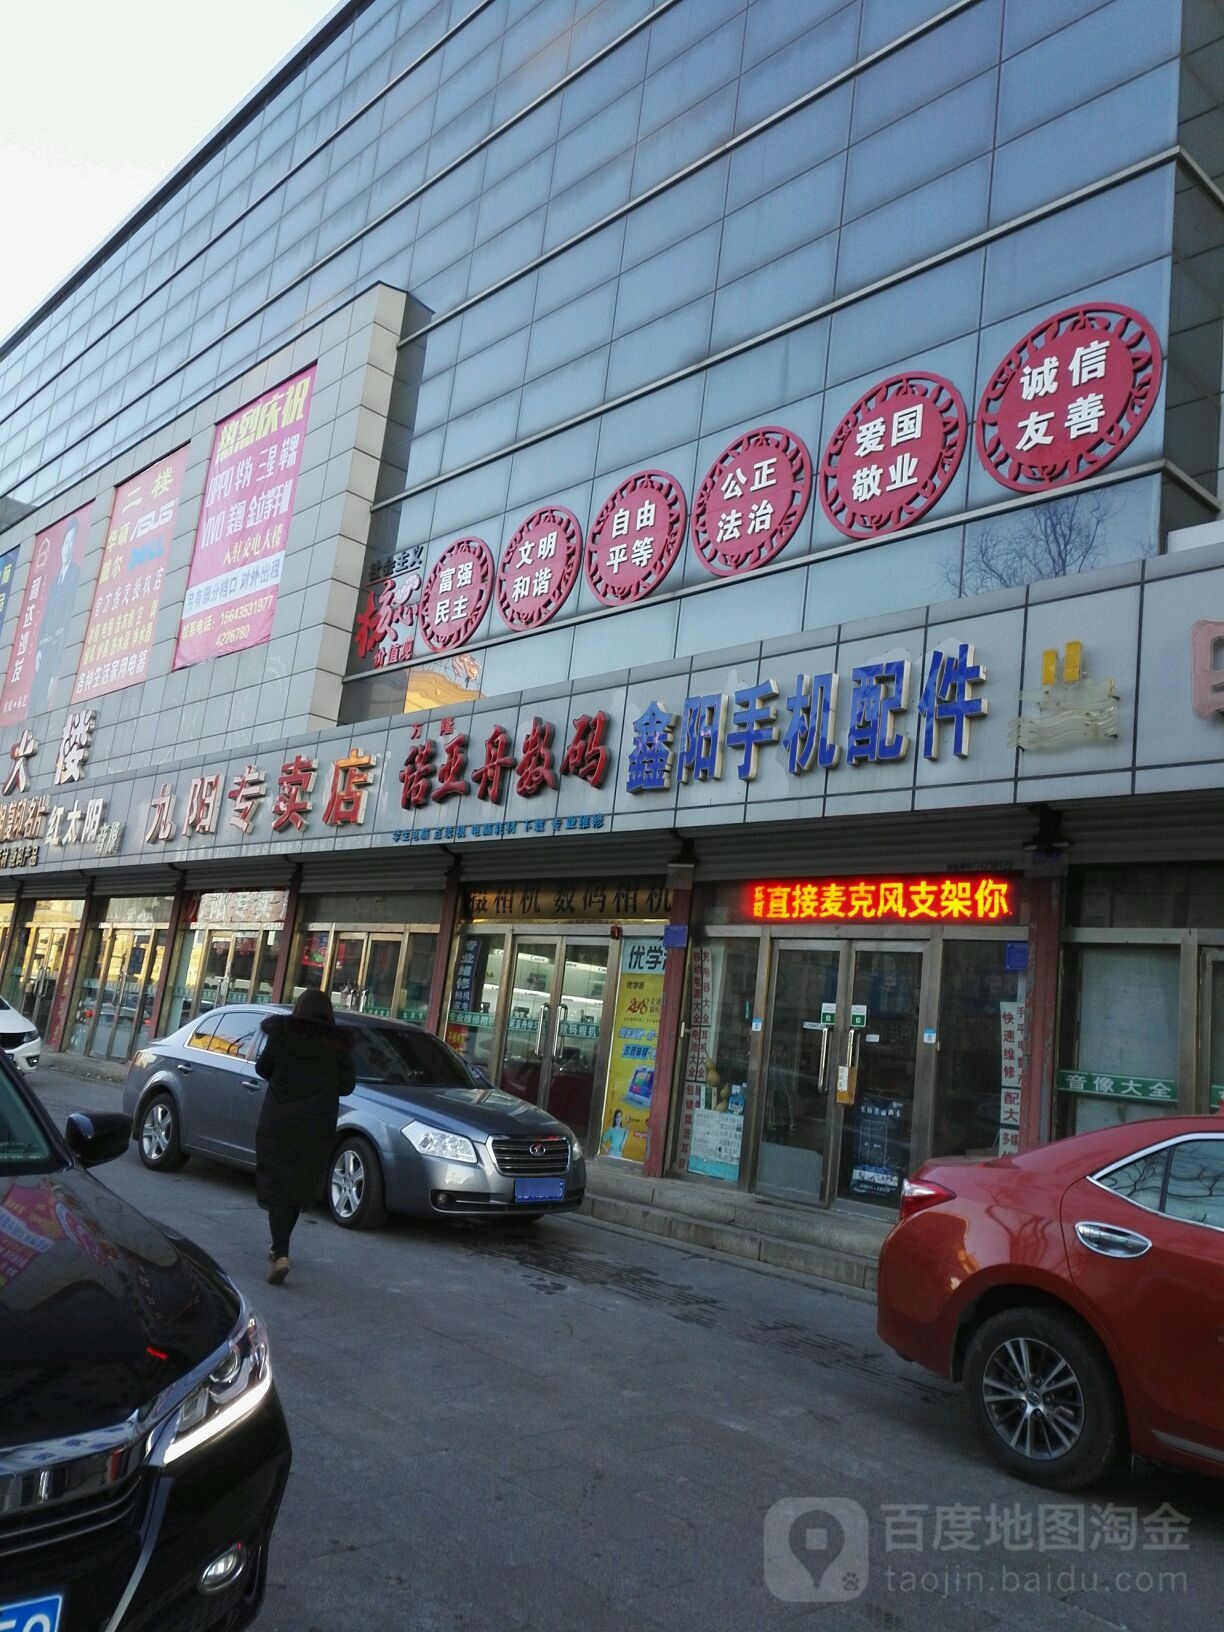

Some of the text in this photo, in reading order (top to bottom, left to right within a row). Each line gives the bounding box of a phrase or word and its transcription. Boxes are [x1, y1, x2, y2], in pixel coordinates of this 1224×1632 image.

[1019, 340, 1111, 402] 诚信
[217, 377, 311, 465] 热烈庆祝
[854, 403, 925, 466] 爱国
[1013, 393, 1106, 458] 友善
[121, 466, 174, 513] 二楼
[205, 433, 301, 508] OPPO 华为 三星 苹果
[720, 457, 778, 500] 公正
[851, 453, 919, 511] 敬业
[247, 479, 293, 528] 金立等手机
[611, 499, 656, 537] 自由
[717, 504, 774, 544] 法治
[107, 523, 131, 552] 华硕
[518, 530, 558, 574] 文明
[239, 557, 281, 592] 对外出租
[368, 545, 424, 581] 社会主义
[438, 560, 474, 600] 富强
[607, 544, 654, 581] 平等
[514, 571, 553, 604] 和谐
[354, 575, 421, 660] 核心
[434, 594, 468, 626] 民主
[76, 649, 148, 694] 各种生活家用电器
[409, 716, 456, 742] 万隆
[627, 643, 990, 803] 鑫阳手机配件
[2, 709, 97, 796] 大楼
[399, 710, 612, 811] 诺亚舟数码
[145, 747, 378, 847] 九阳专卖店
[45, 798, 104, 847] 红太阳
[471, 820, 518, 838] 电脑耗材
[523, 818, 546, 835] 下载
[551, 813, 605, 833] 专业维修
[553, 884, 671, 914] 数码相机
[627, 945, 667, 970] 优学
[560, 1023, 598, 1037] 数码相机
[1002, 1011, 1015, 1080] 快速维修
[1066, 1074, 1172, 1099] 音像大全
